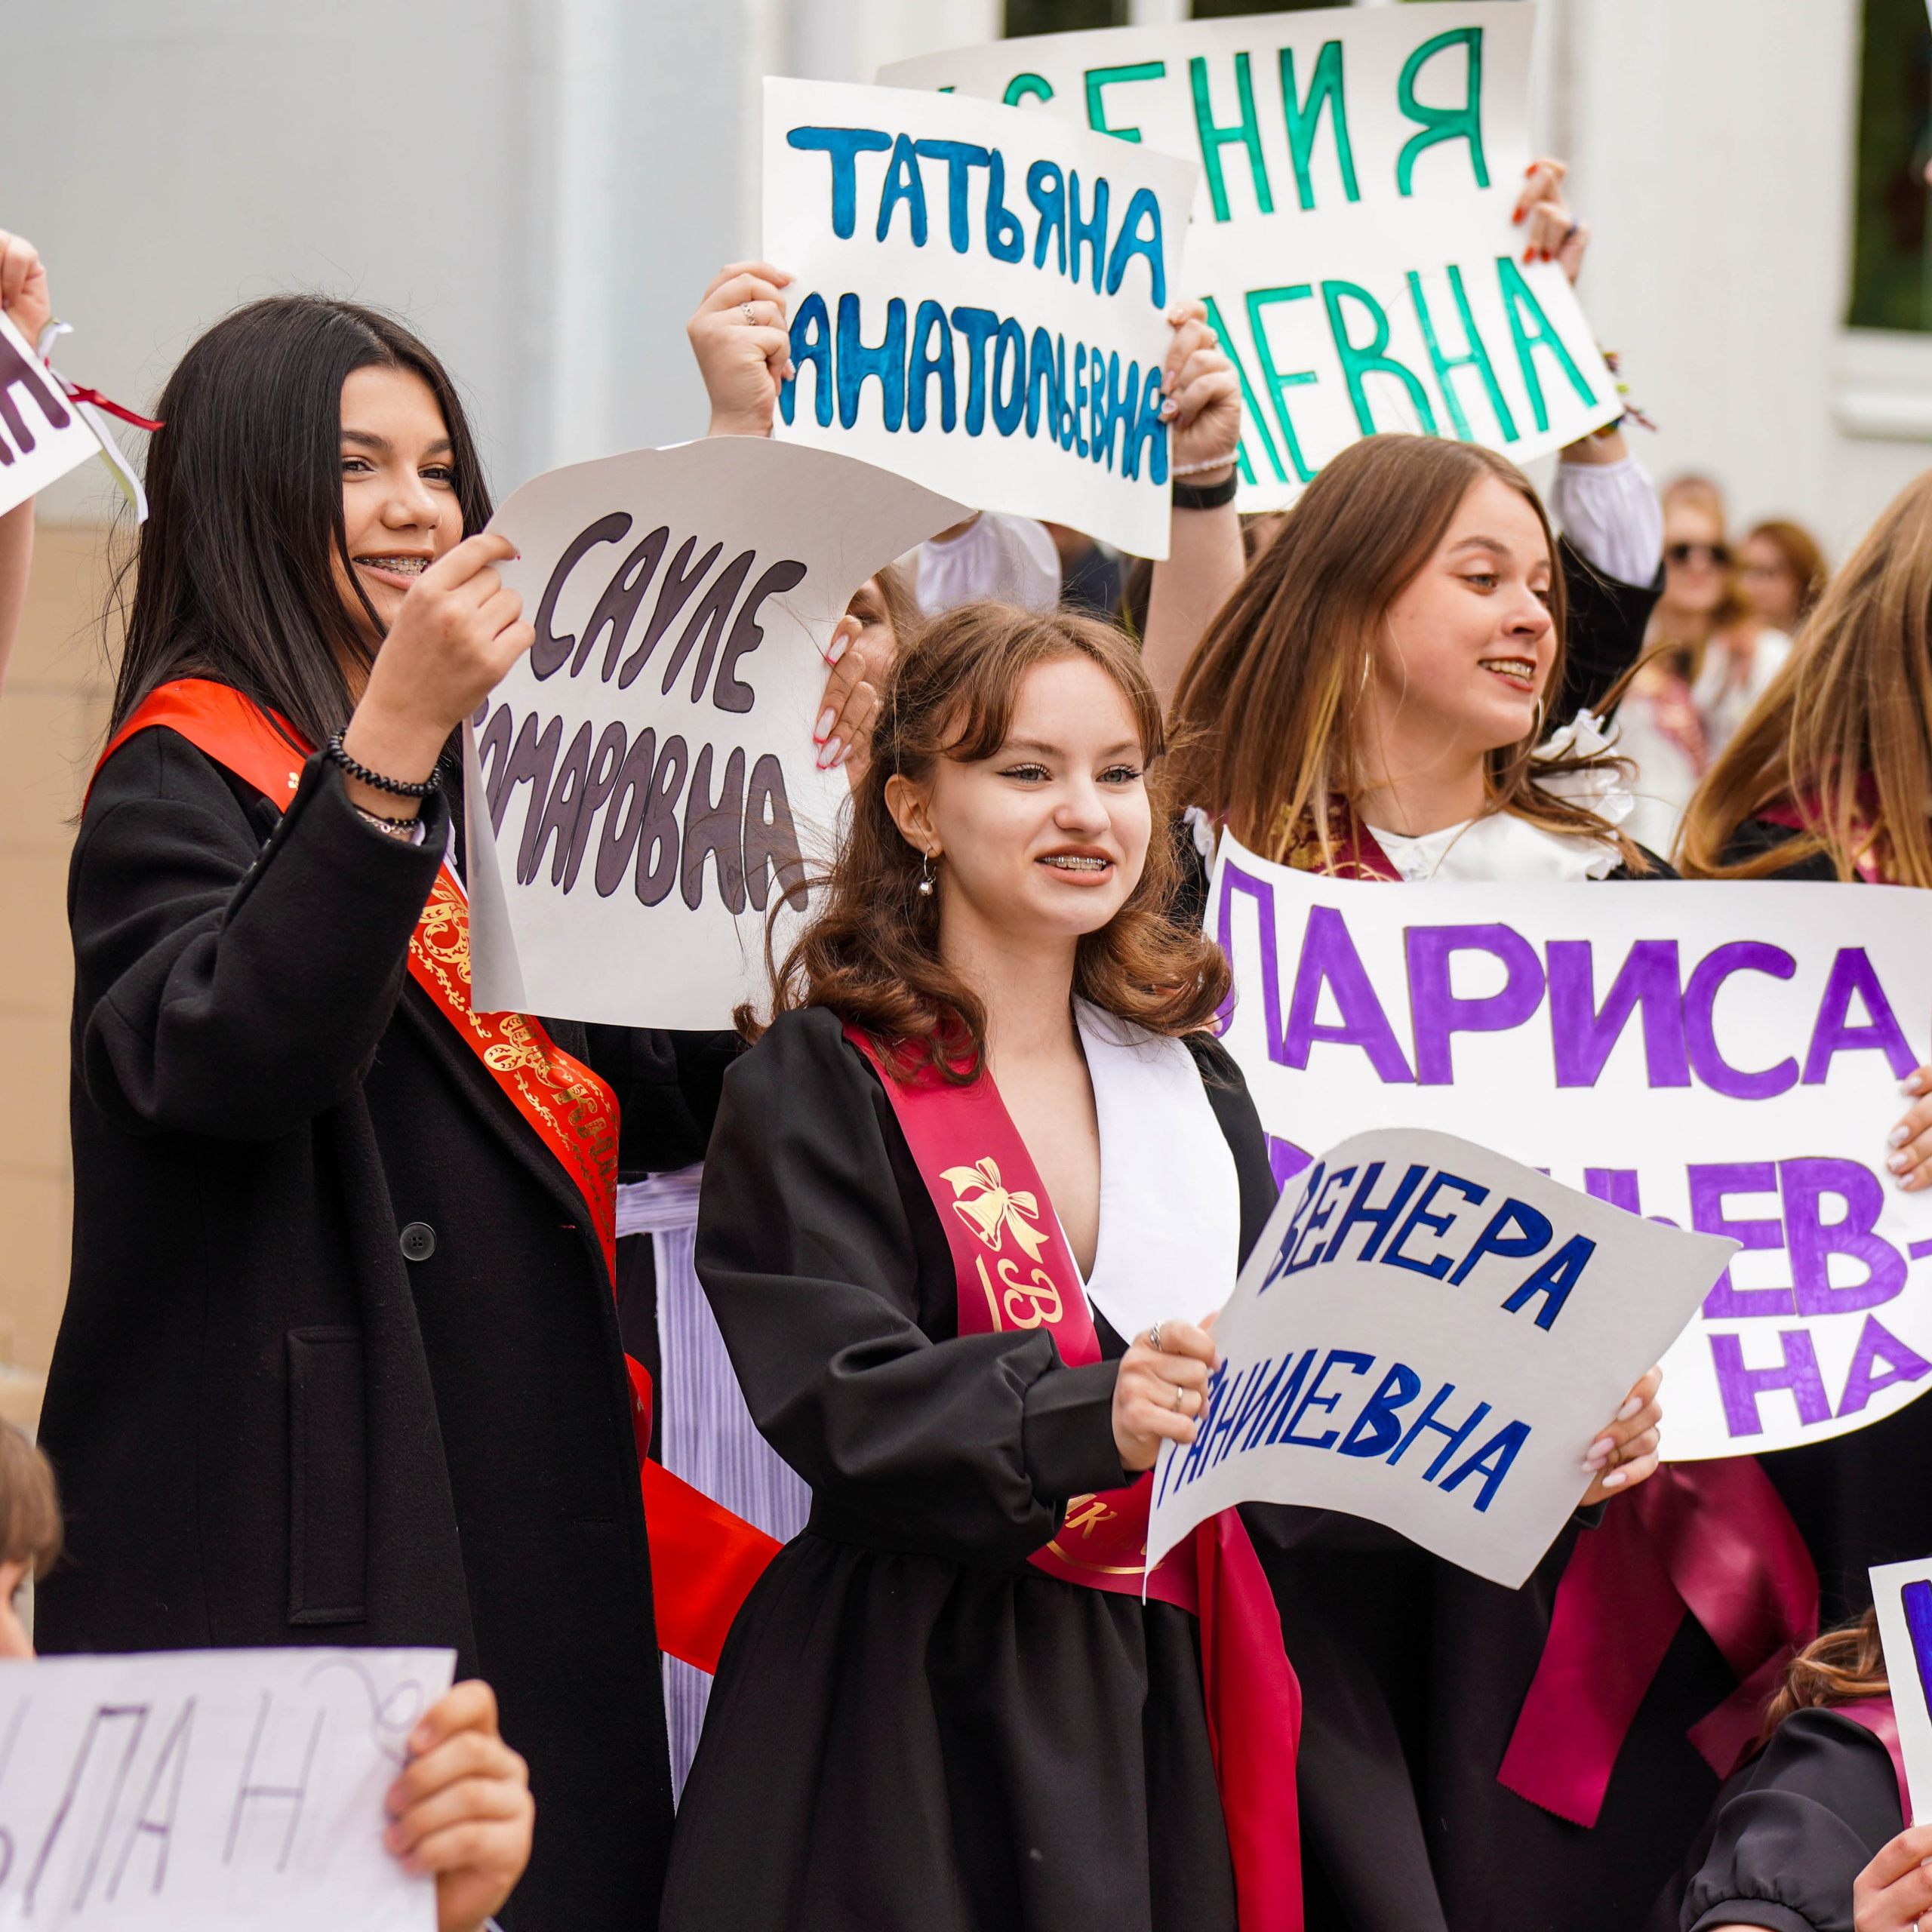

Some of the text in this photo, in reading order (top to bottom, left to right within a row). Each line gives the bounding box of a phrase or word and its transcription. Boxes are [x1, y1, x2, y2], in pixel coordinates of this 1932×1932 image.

[786, 126, 1165, 309] ТАТЬЯНА
[938, 27, 1490, 224] ЕНИЯ
[778, 291, 1168, 485] АНАТОЛЬЕВНА
[531, 511, 807, 713] САУЛЕ
[1214, 857, 1921, 1100] ЛАРИСА
[1257, 1161, 1597, 1332] ВЕНЕРА
[1708, 1313, 1932, 1438] НА
